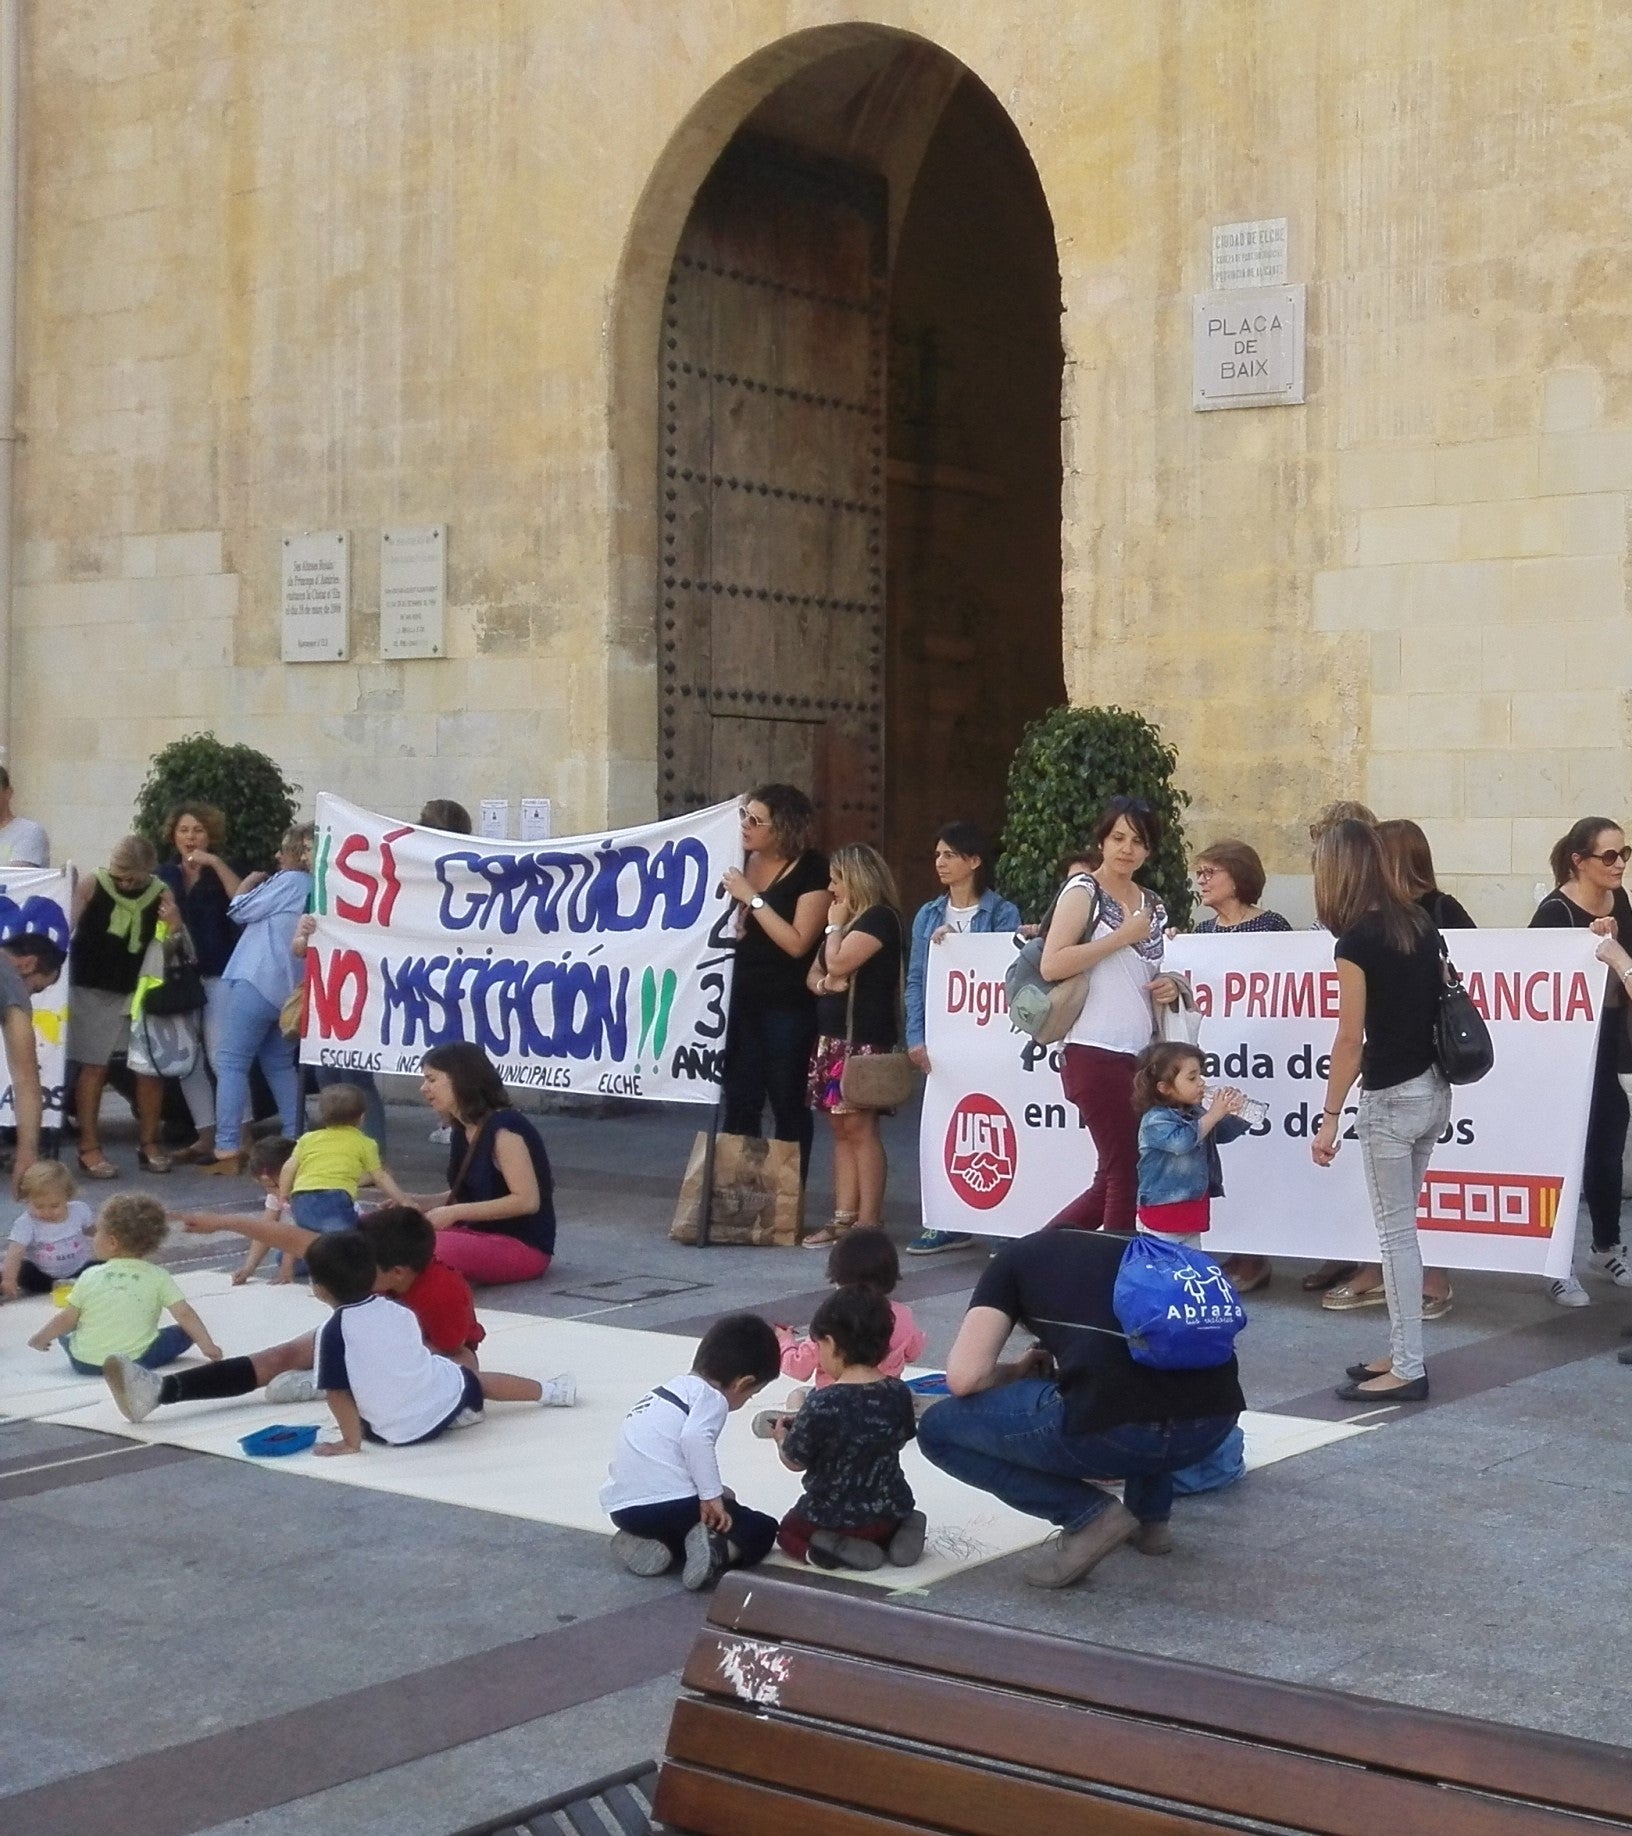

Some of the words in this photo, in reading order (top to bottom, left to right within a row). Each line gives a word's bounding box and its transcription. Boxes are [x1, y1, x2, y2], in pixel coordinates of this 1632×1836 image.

[1234, 339, 1258, 355] DE
[1221, 358, 1269, 379] BAIX
[300, 946, 368, 1042] NO
[947, 969, 1009, 1026] Dign
[1224, 972, 1340, 1018] PRIME
[1456, 972, 1594, 1022] ANCIA
[320, 1048, 382, 1071] ESCUELAS
[395, 1051, 425, 1074] INFA
[597, 1072, 643, 1097] ELCHE
[1024, 1103, 1066, 1129] en
[955, 1112, 1008, 1158] UGT
[1167, 1303, 1242, 1319] Abraza
